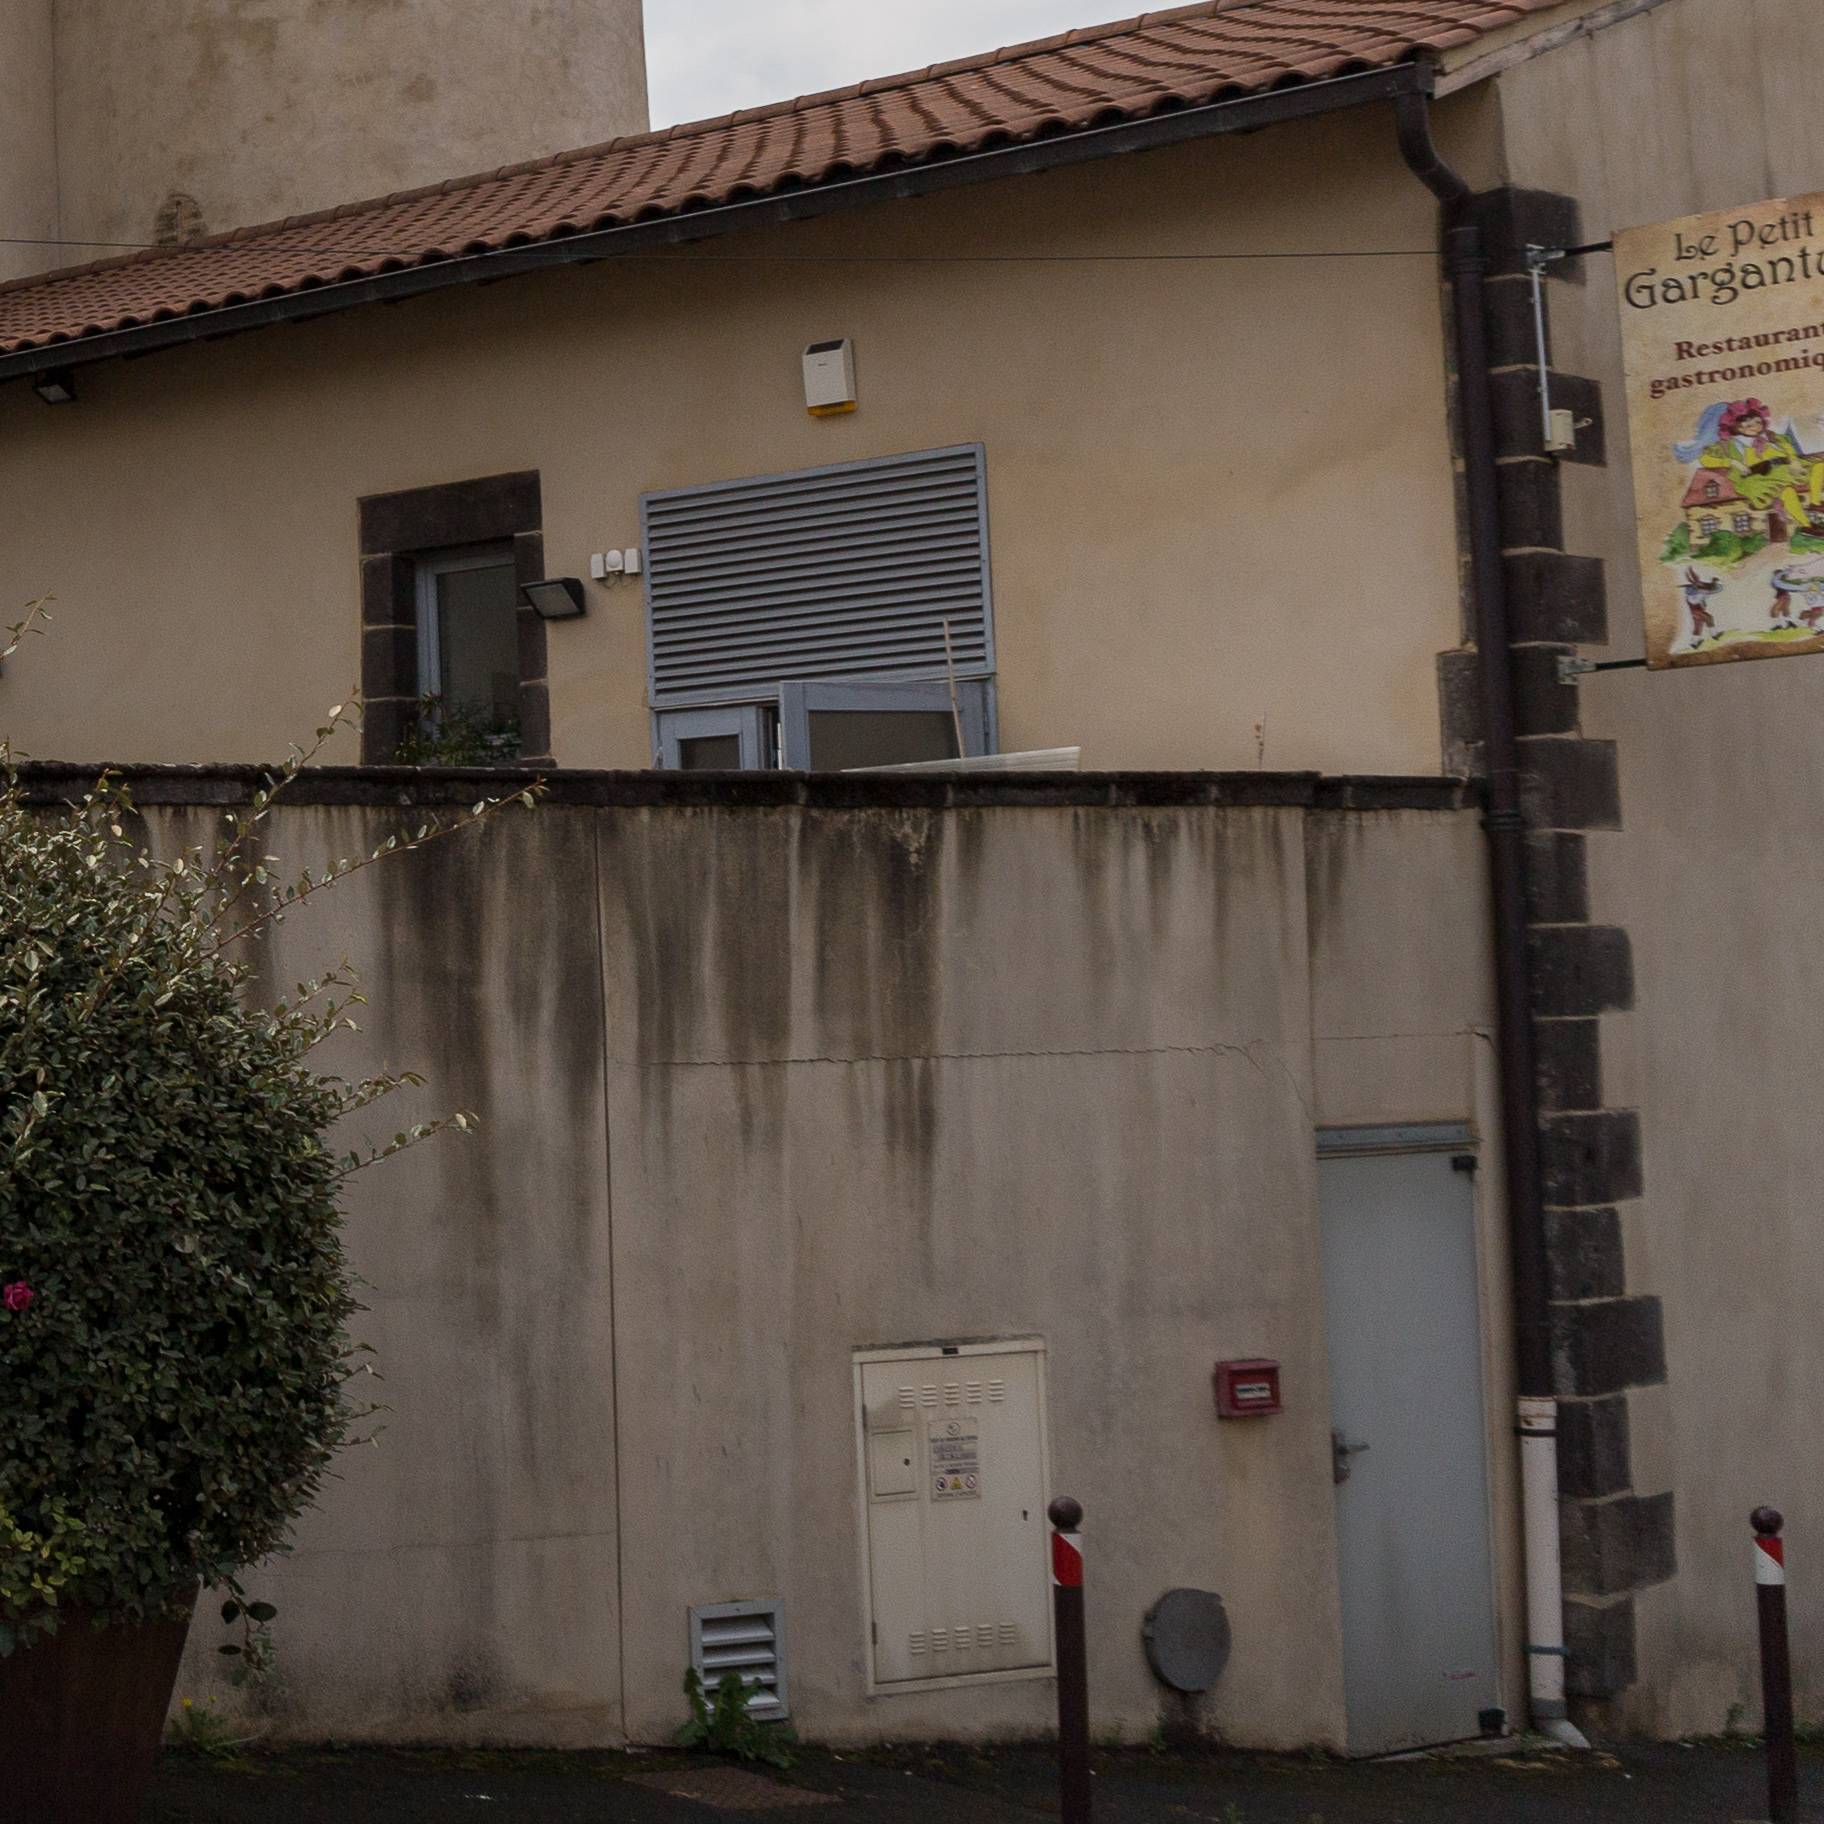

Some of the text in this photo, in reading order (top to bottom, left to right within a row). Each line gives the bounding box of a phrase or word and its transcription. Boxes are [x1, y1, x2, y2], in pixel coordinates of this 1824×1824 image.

[1674, 210, 1814, 261] Le Petit
[1625, 246, 1824, 309] Gargant
